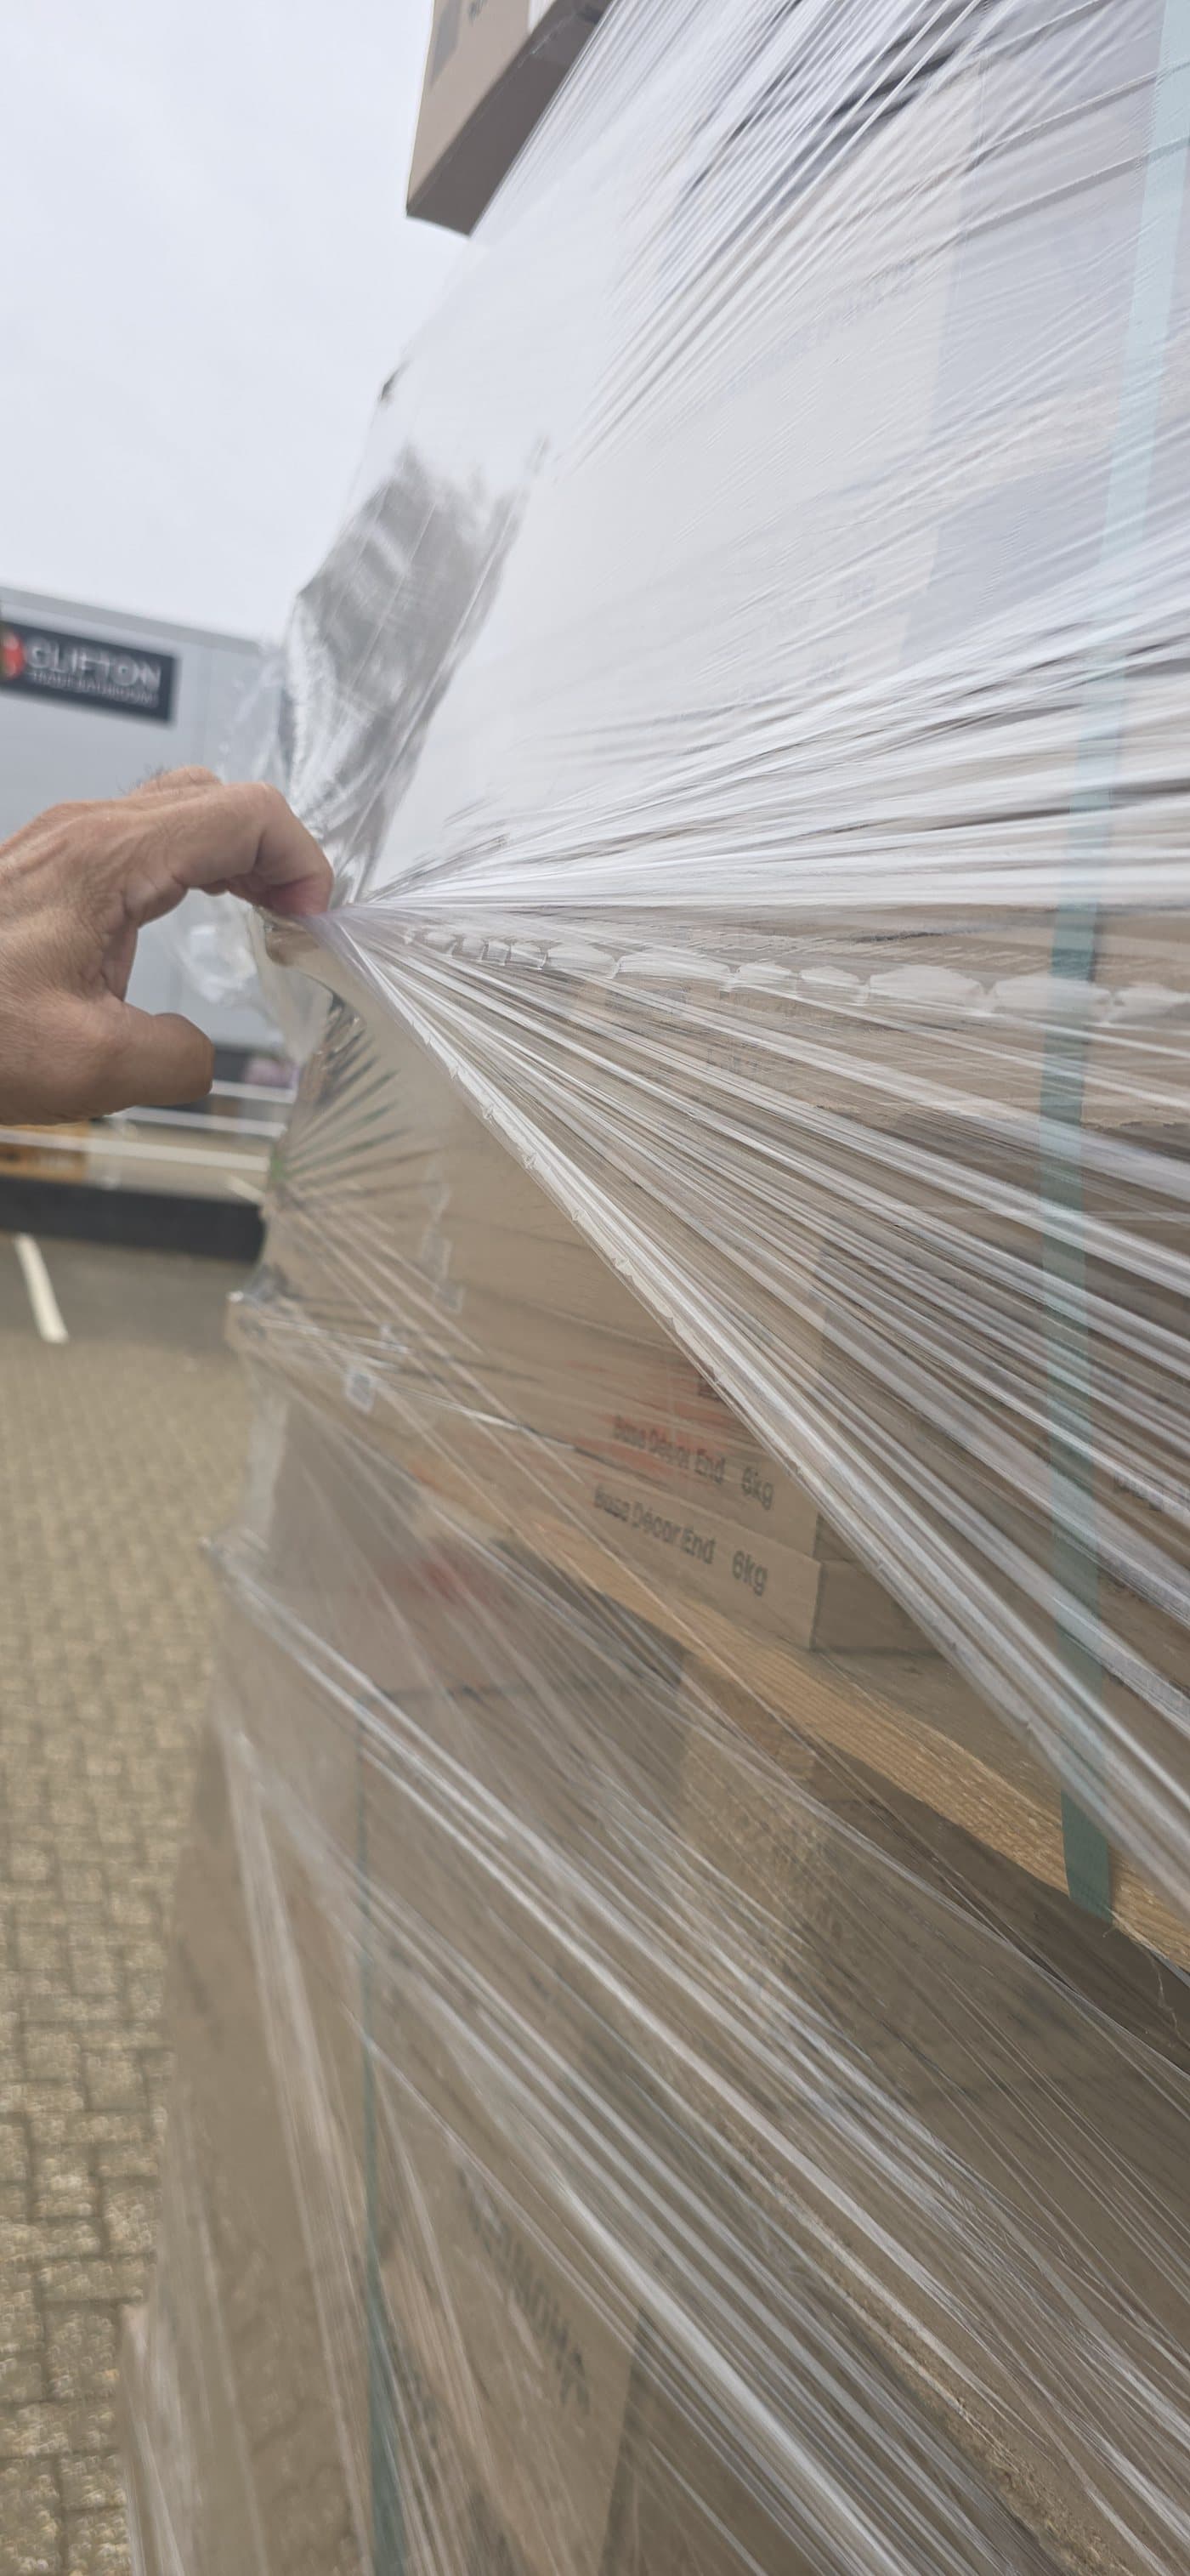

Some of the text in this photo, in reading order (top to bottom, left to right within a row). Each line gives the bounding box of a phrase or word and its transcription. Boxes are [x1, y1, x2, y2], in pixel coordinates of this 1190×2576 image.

[26, 635, 162, 691] CLIFTON
[694, 1448, 726, 1484] End
[632, 1501, 681, 1544] Décor
[680, 1529, 717, 1565] End
[732, 1549, 768, 1597] 6kg
